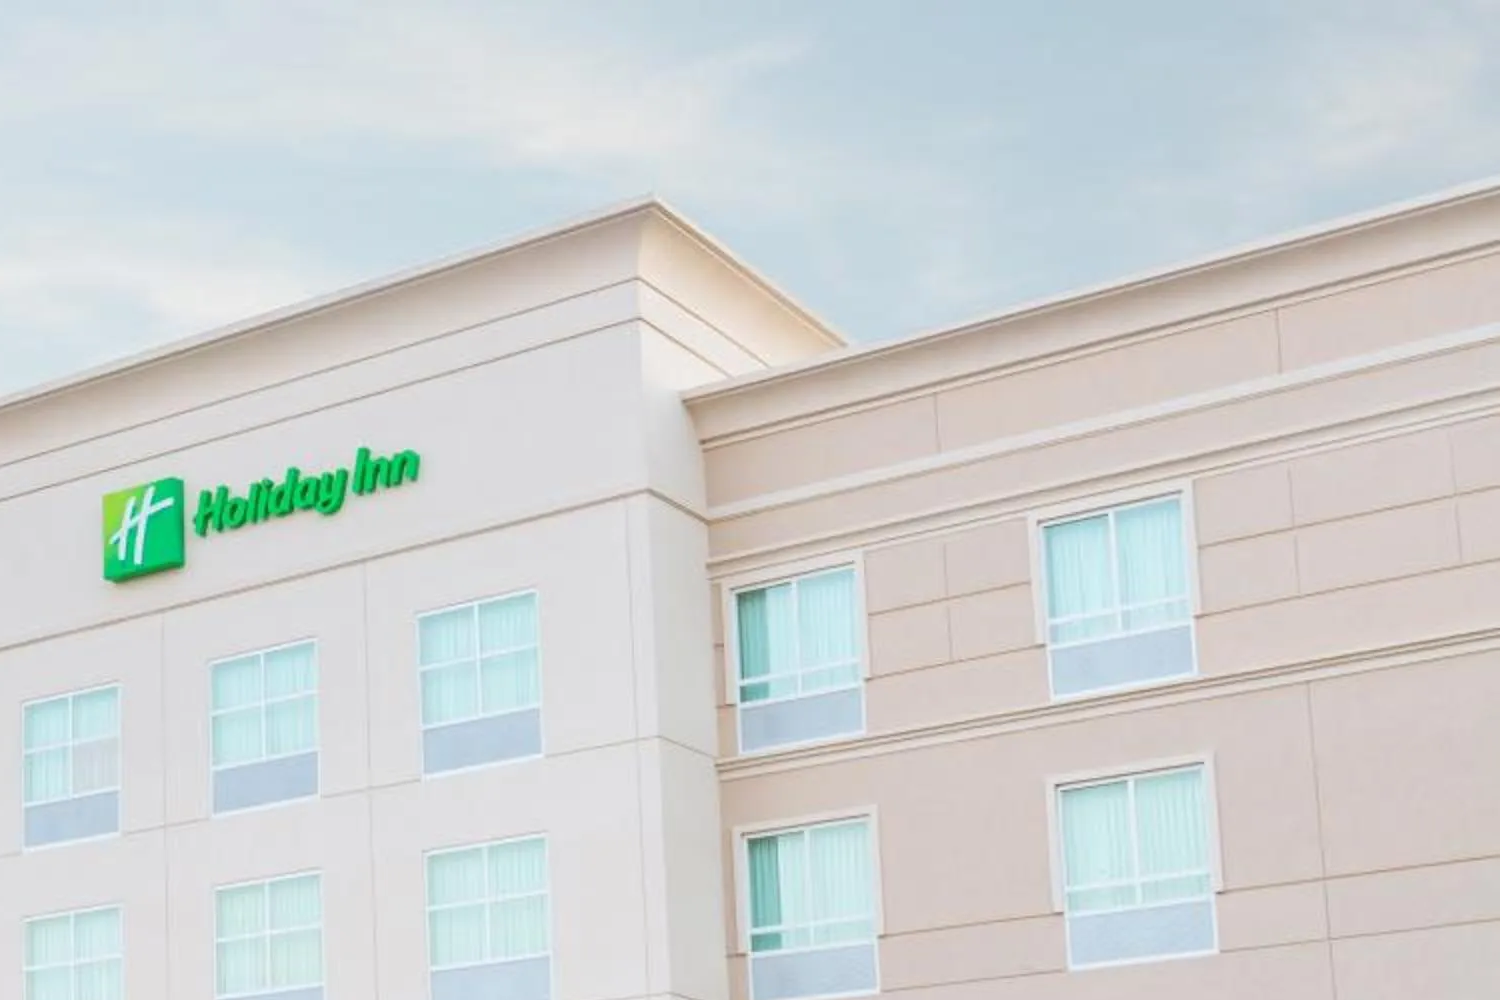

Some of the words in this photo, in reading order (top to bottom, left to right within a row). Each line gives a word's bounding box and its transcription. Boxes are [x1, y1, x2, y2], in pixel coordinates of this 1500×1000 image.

[109, 485, 175, 564] H
[193, 466, 348, 536] Holiday
[352, 447, 421, 495] Inn
